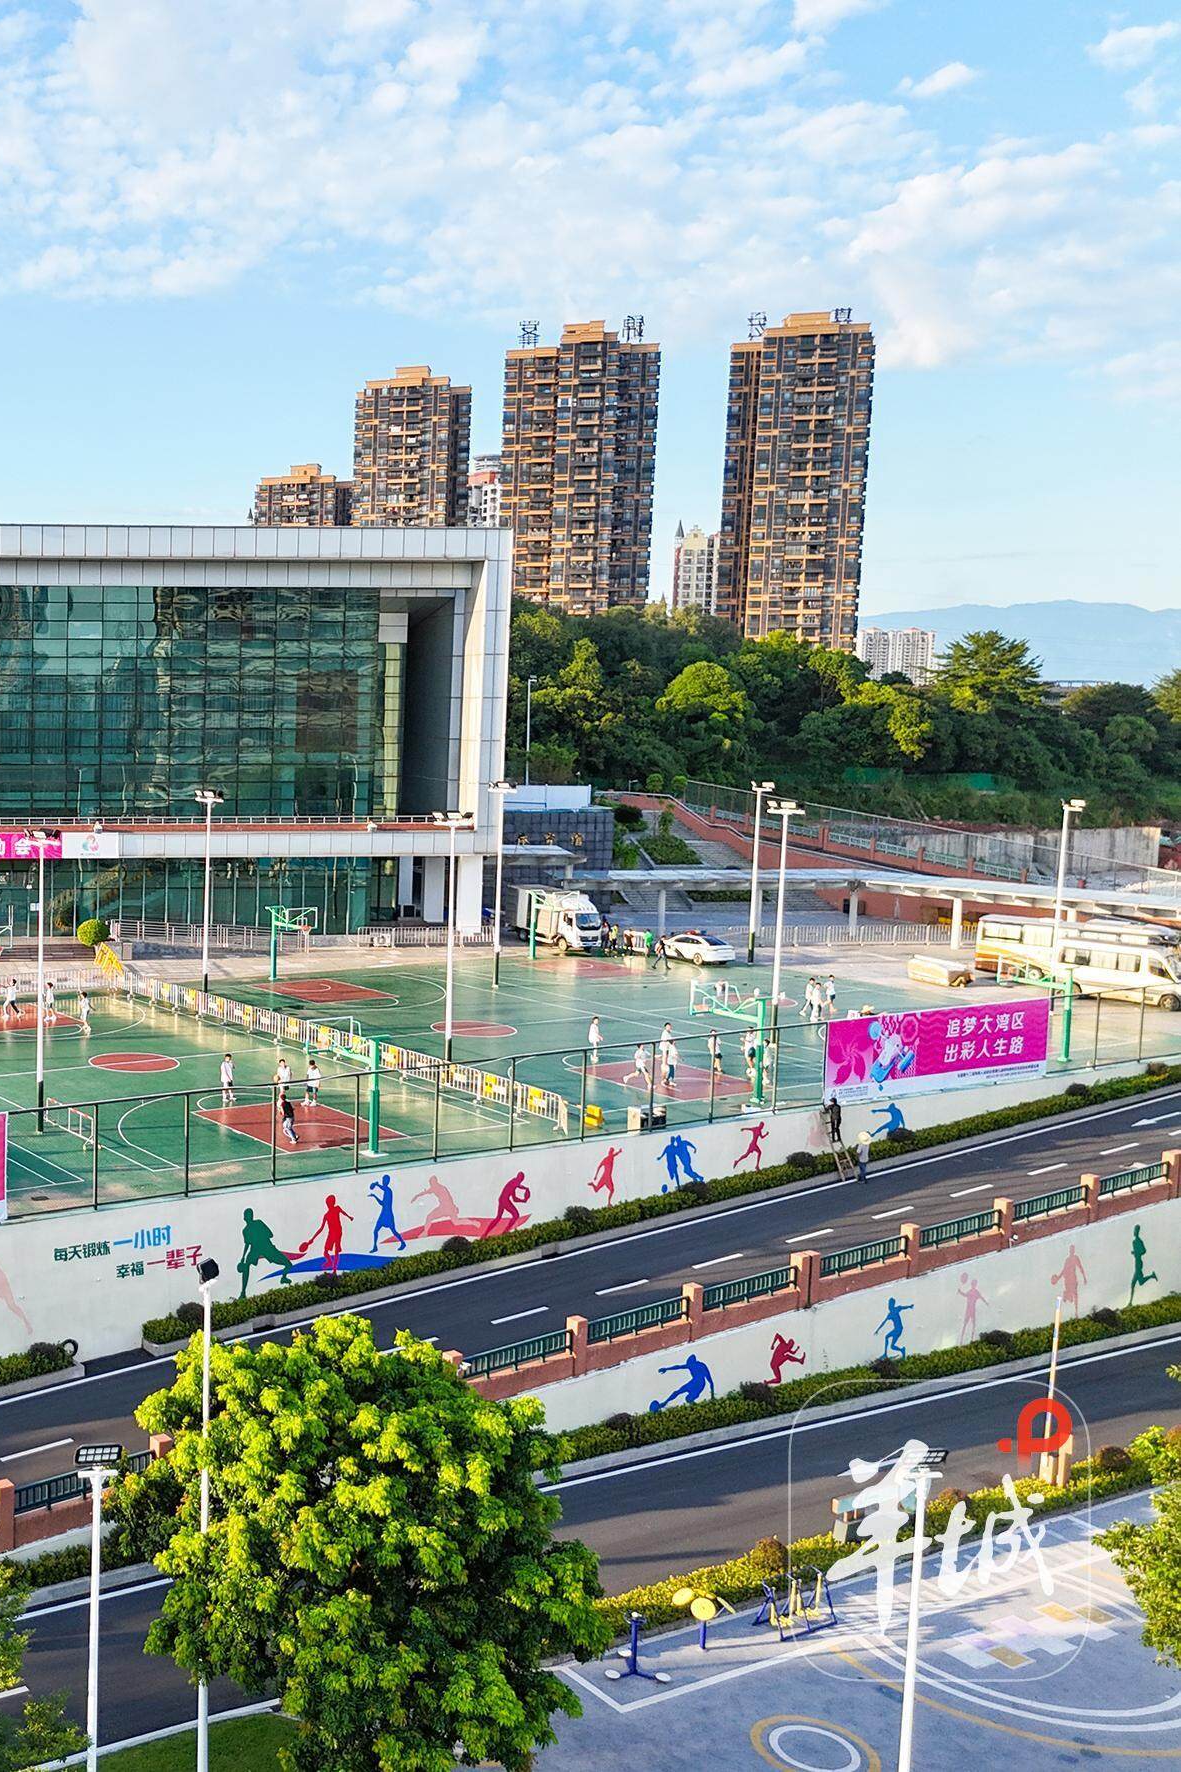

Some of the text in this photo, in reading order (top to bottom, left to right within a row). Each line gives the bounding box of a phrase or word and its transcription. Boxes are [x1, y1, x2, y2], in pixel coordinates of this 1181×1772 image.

[946, 1011, 1025, 1038] 追梦大湾区
[944, 1036, 1025, 1063] 出彩人生路
[53, 1225, 172, 1262] 每天锻炼一小时
[116, 1244, 203, 1279] 幸福一辈子
